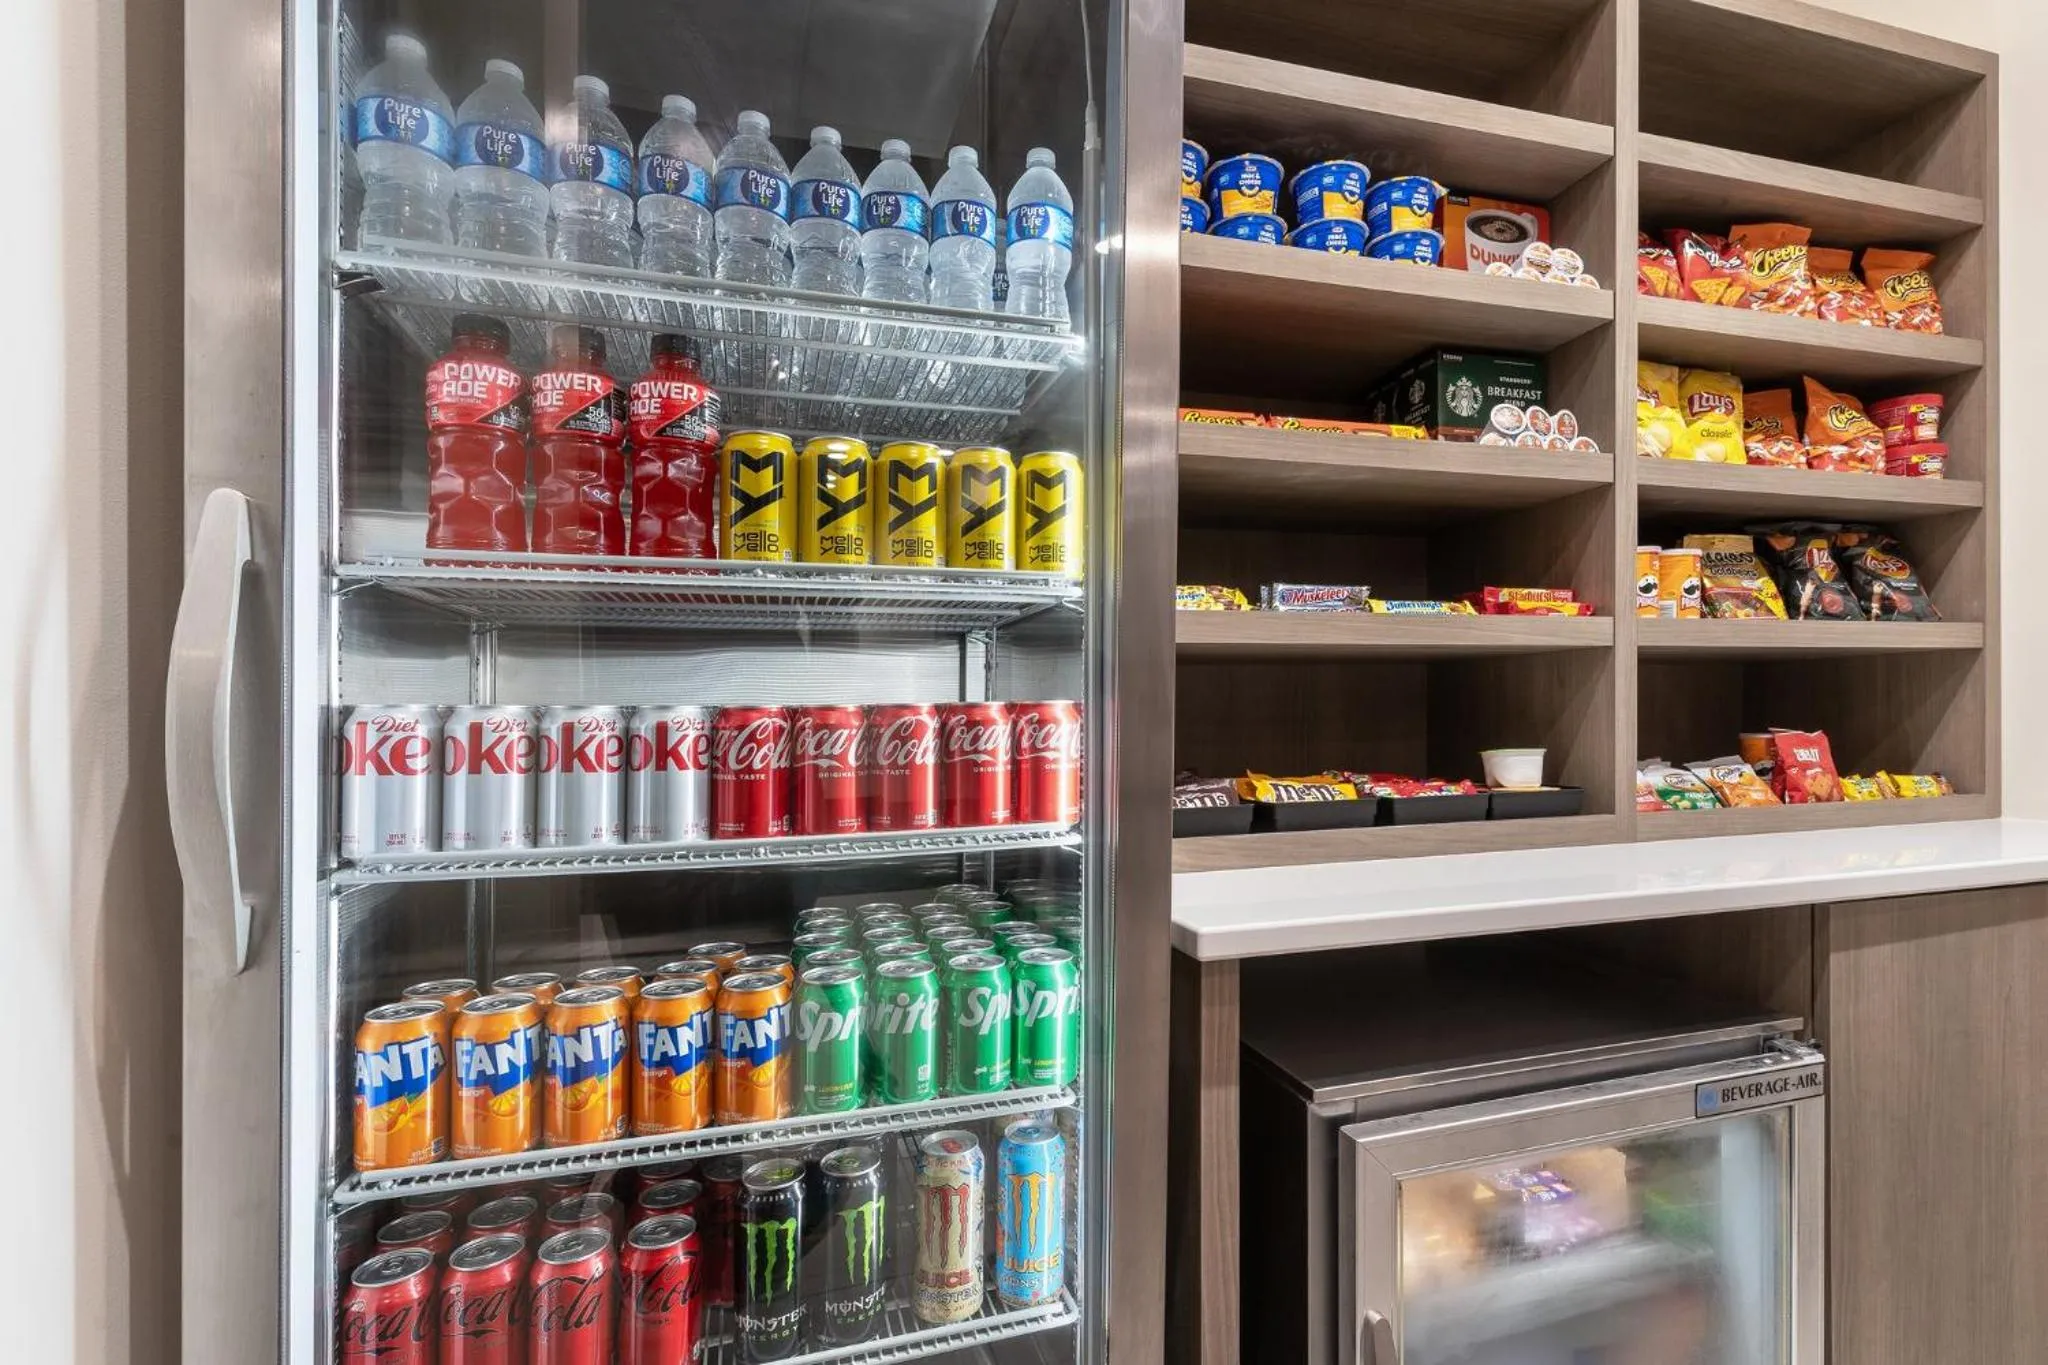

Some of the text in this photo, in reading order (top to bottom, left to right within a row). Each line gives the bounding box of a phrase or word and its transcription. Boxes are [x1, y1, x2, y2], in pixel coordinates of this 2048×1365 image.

[383, 97, 422, 119] Pure
[387, 110, 417, 131] Life
[482, 124, 518, 145] Pure
[486, 137, 513, 156] Life
[565, 141, 598, 157] Pure
[568, 153, 594, 168] Life
[653, 154, 685, 172] Pure
[656, 167, 680, 182] Life
[748, 169, 779, 190] Pure
[751, 181, 774, 198] Life
[818, 181, 847, 198] Pure
[821, 194, 844, 208] Life
[870, 193, 897, 207] Pure
[957, 201, 985, 216] Pure
[872, 203, 894, 218] Life
[960, 212, 981, 226] Life
[1020, 206, 1047, 219] Pure
[1022, 215, 1043, 228] Life
[444, 362, 521, 388] POWER
[532, 373, 603, 394] POWER
[630, 382, 698, 401] POWER
[1487, 385, 1543, 401] BREAKFAST
[1692, 392, 1734, 414] Lay's
[1700, 429, 1733, 438] Classic
[371, 714, 421, 733] Diet
[1721, 1072, 1819, 1104] BEVERAGE-AIR
[1003, 1254, 1060, 1273] JUICE
